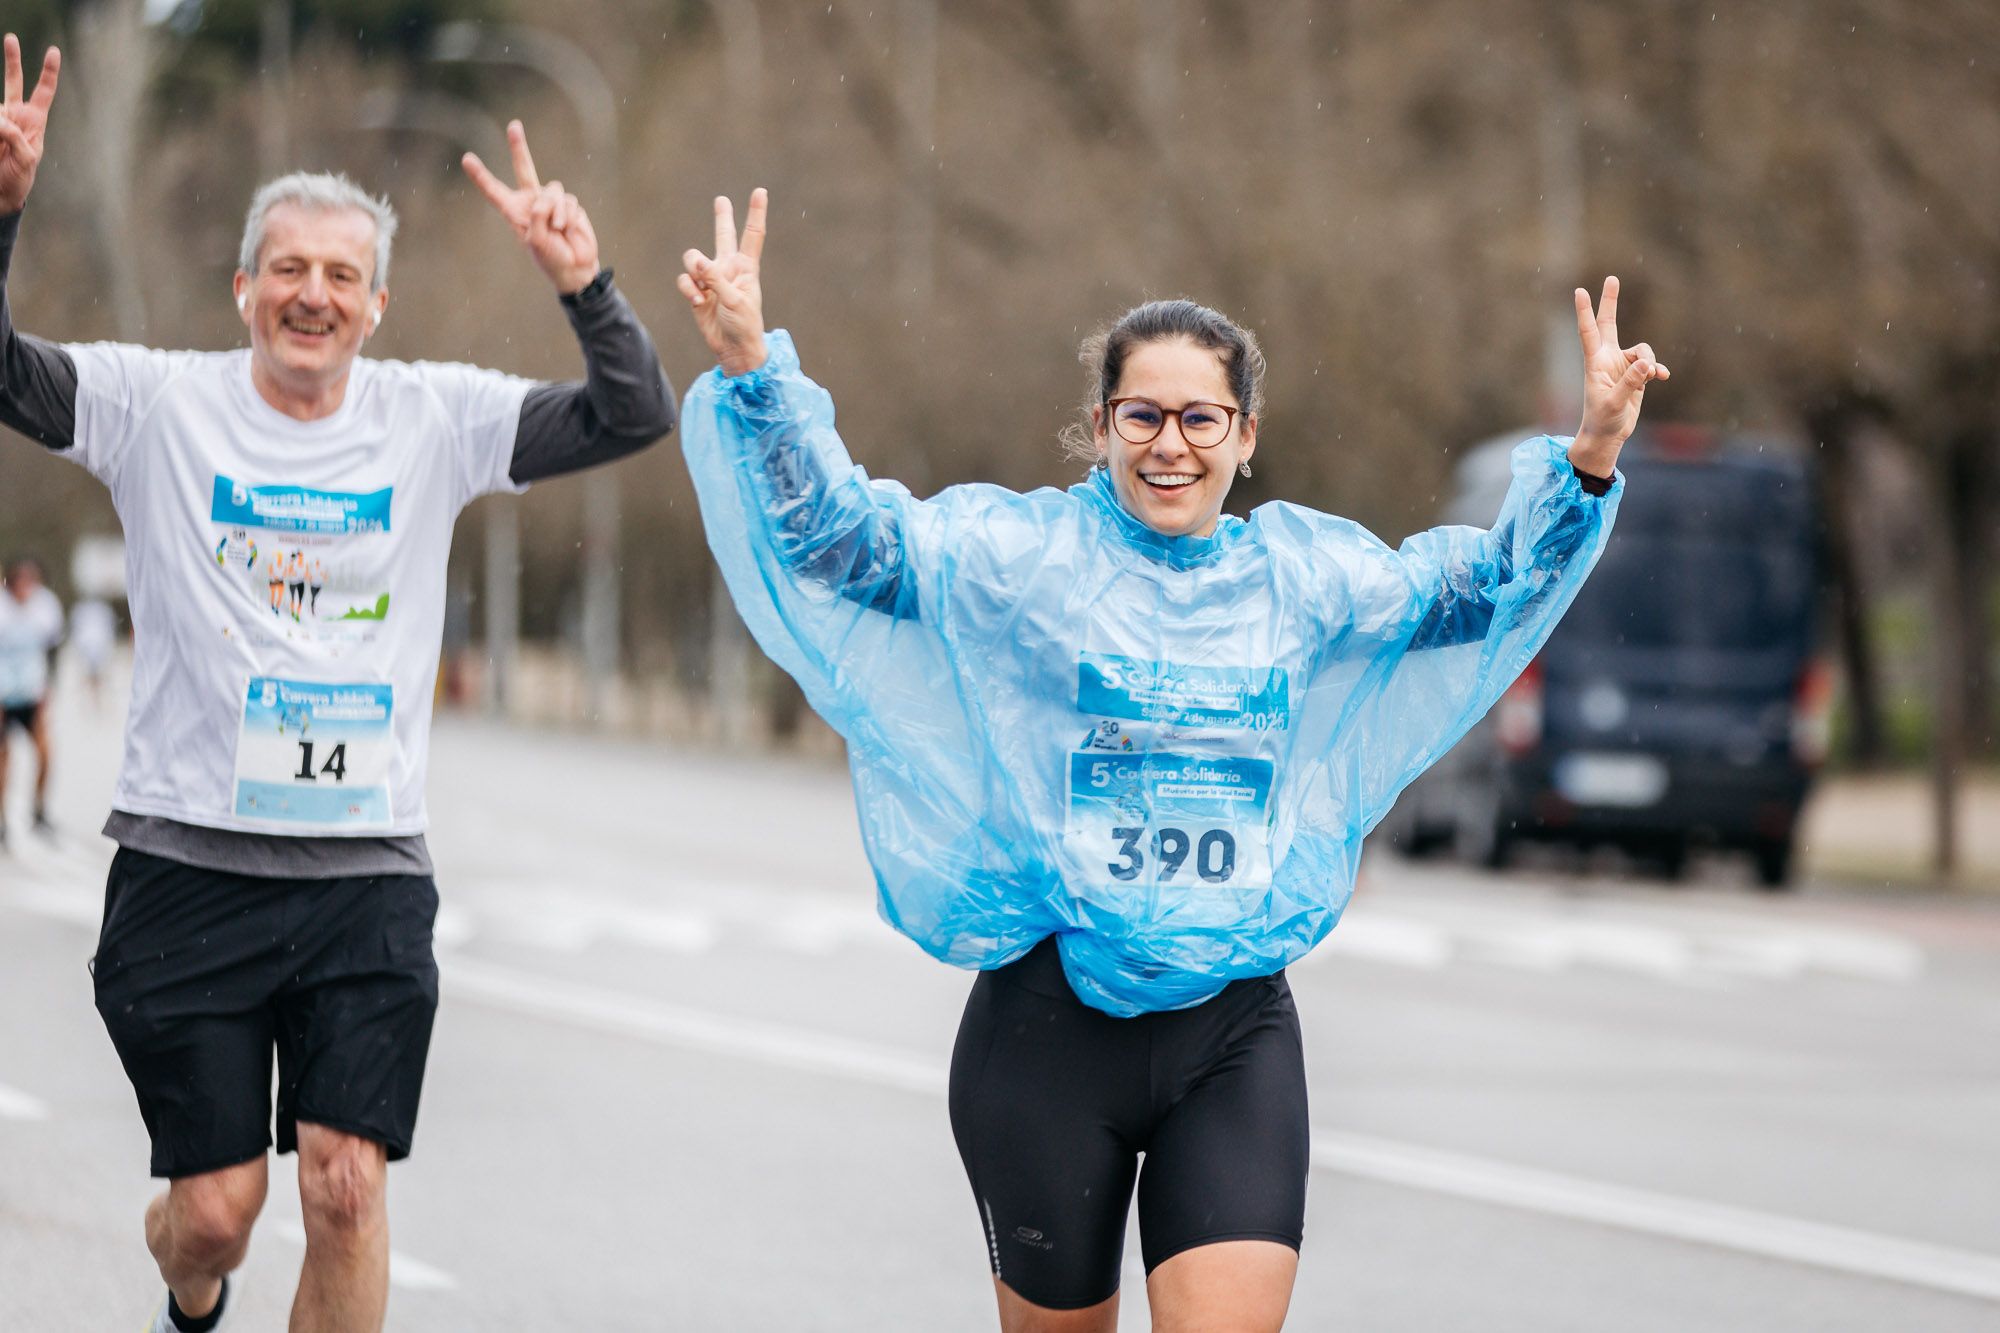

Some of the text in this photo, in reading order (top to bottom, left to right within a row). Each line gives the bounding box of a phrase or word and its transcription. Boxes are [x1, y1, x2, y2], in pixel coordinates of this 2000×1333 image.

[295, 741, 346, 781] 14
[1182, 767, 1241, 783] Solidaria
[1108, 827, 1236, 884] 390
